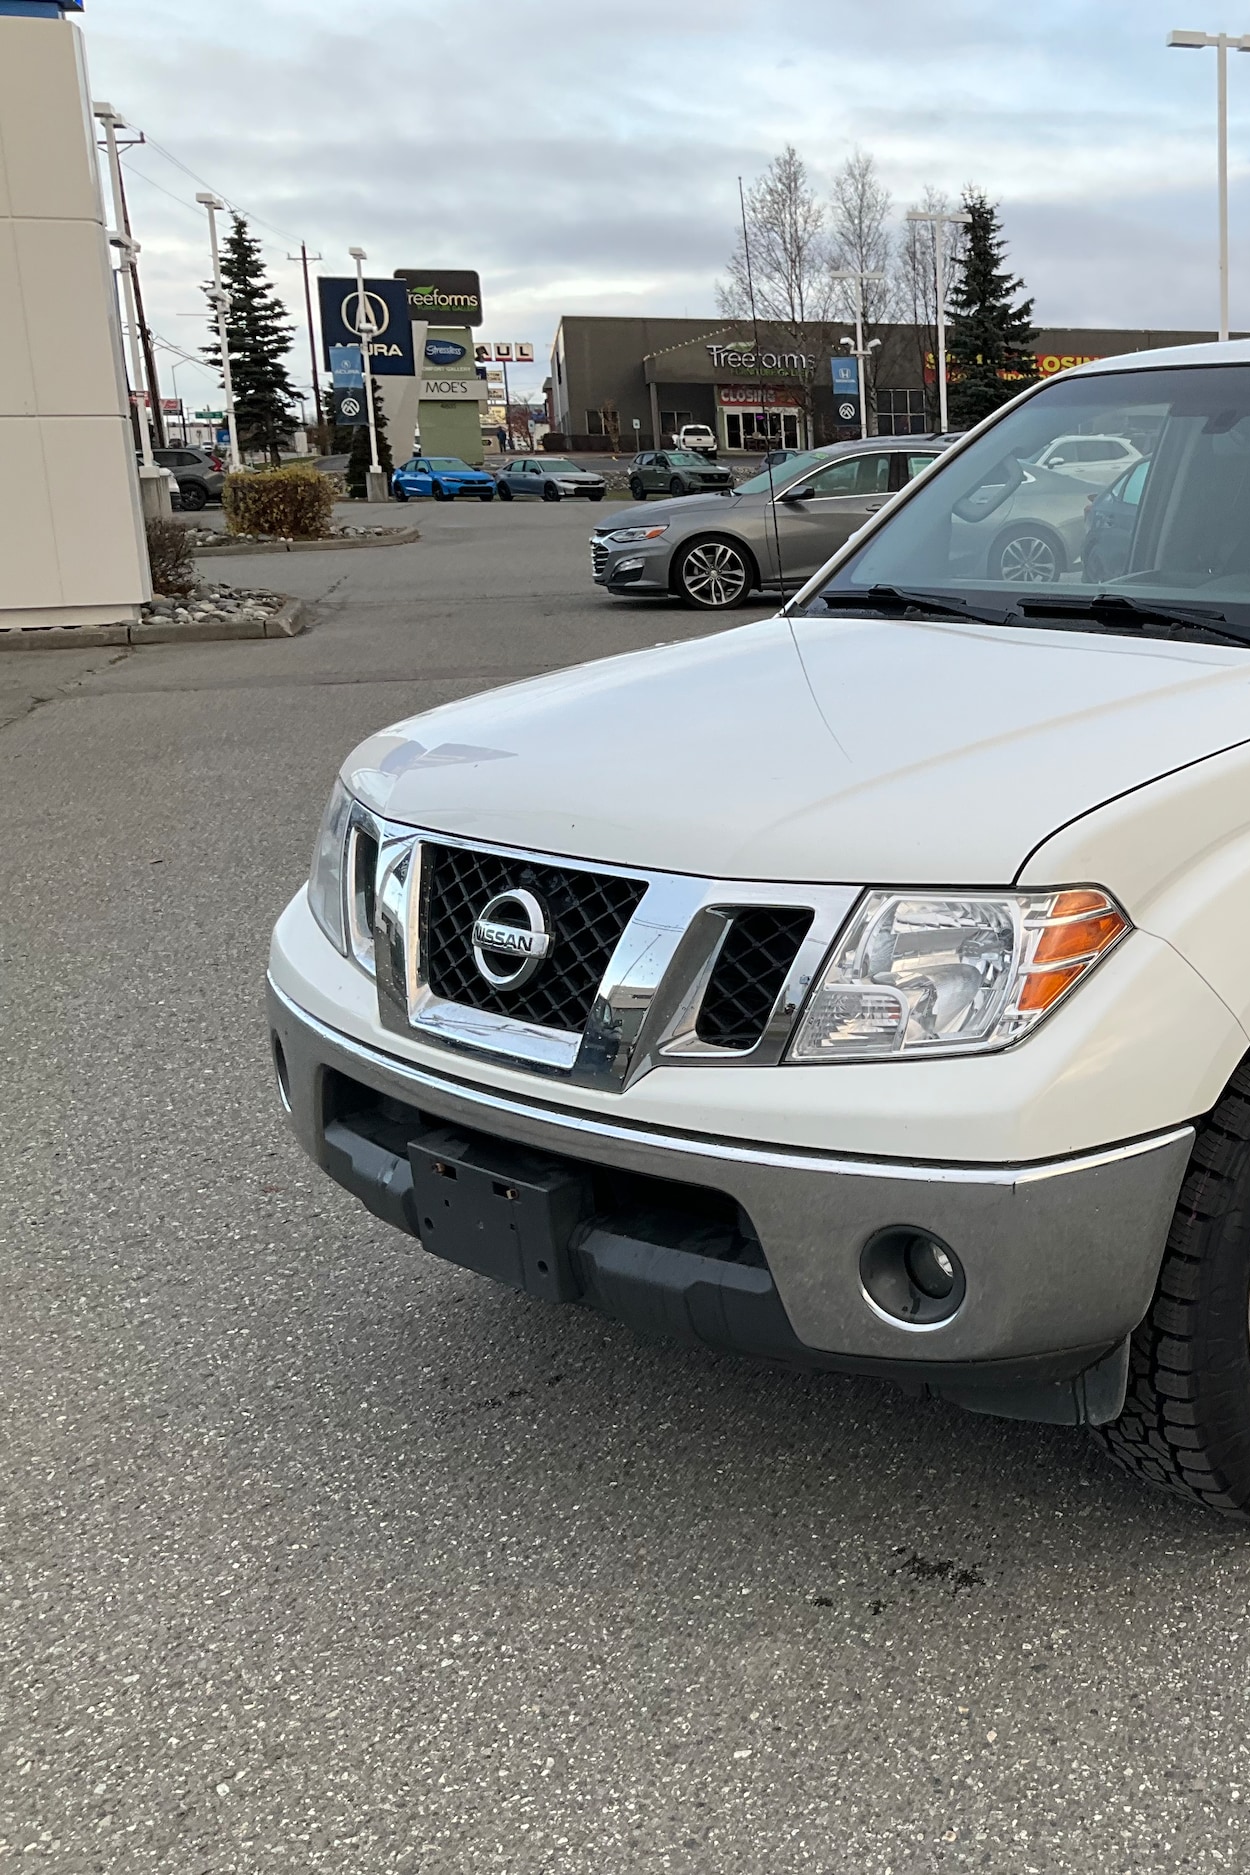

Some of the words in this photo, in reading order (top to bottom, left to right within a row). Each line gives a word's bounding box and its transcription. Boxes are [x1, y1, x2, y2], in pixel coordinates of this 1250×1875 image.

[406, 288, 478, 307] reeforms
[425, 381, 468, 394] MOE'S
[720, 388, 777, 403] CLOSING
[474, 922, 534, 953] NISSAN
